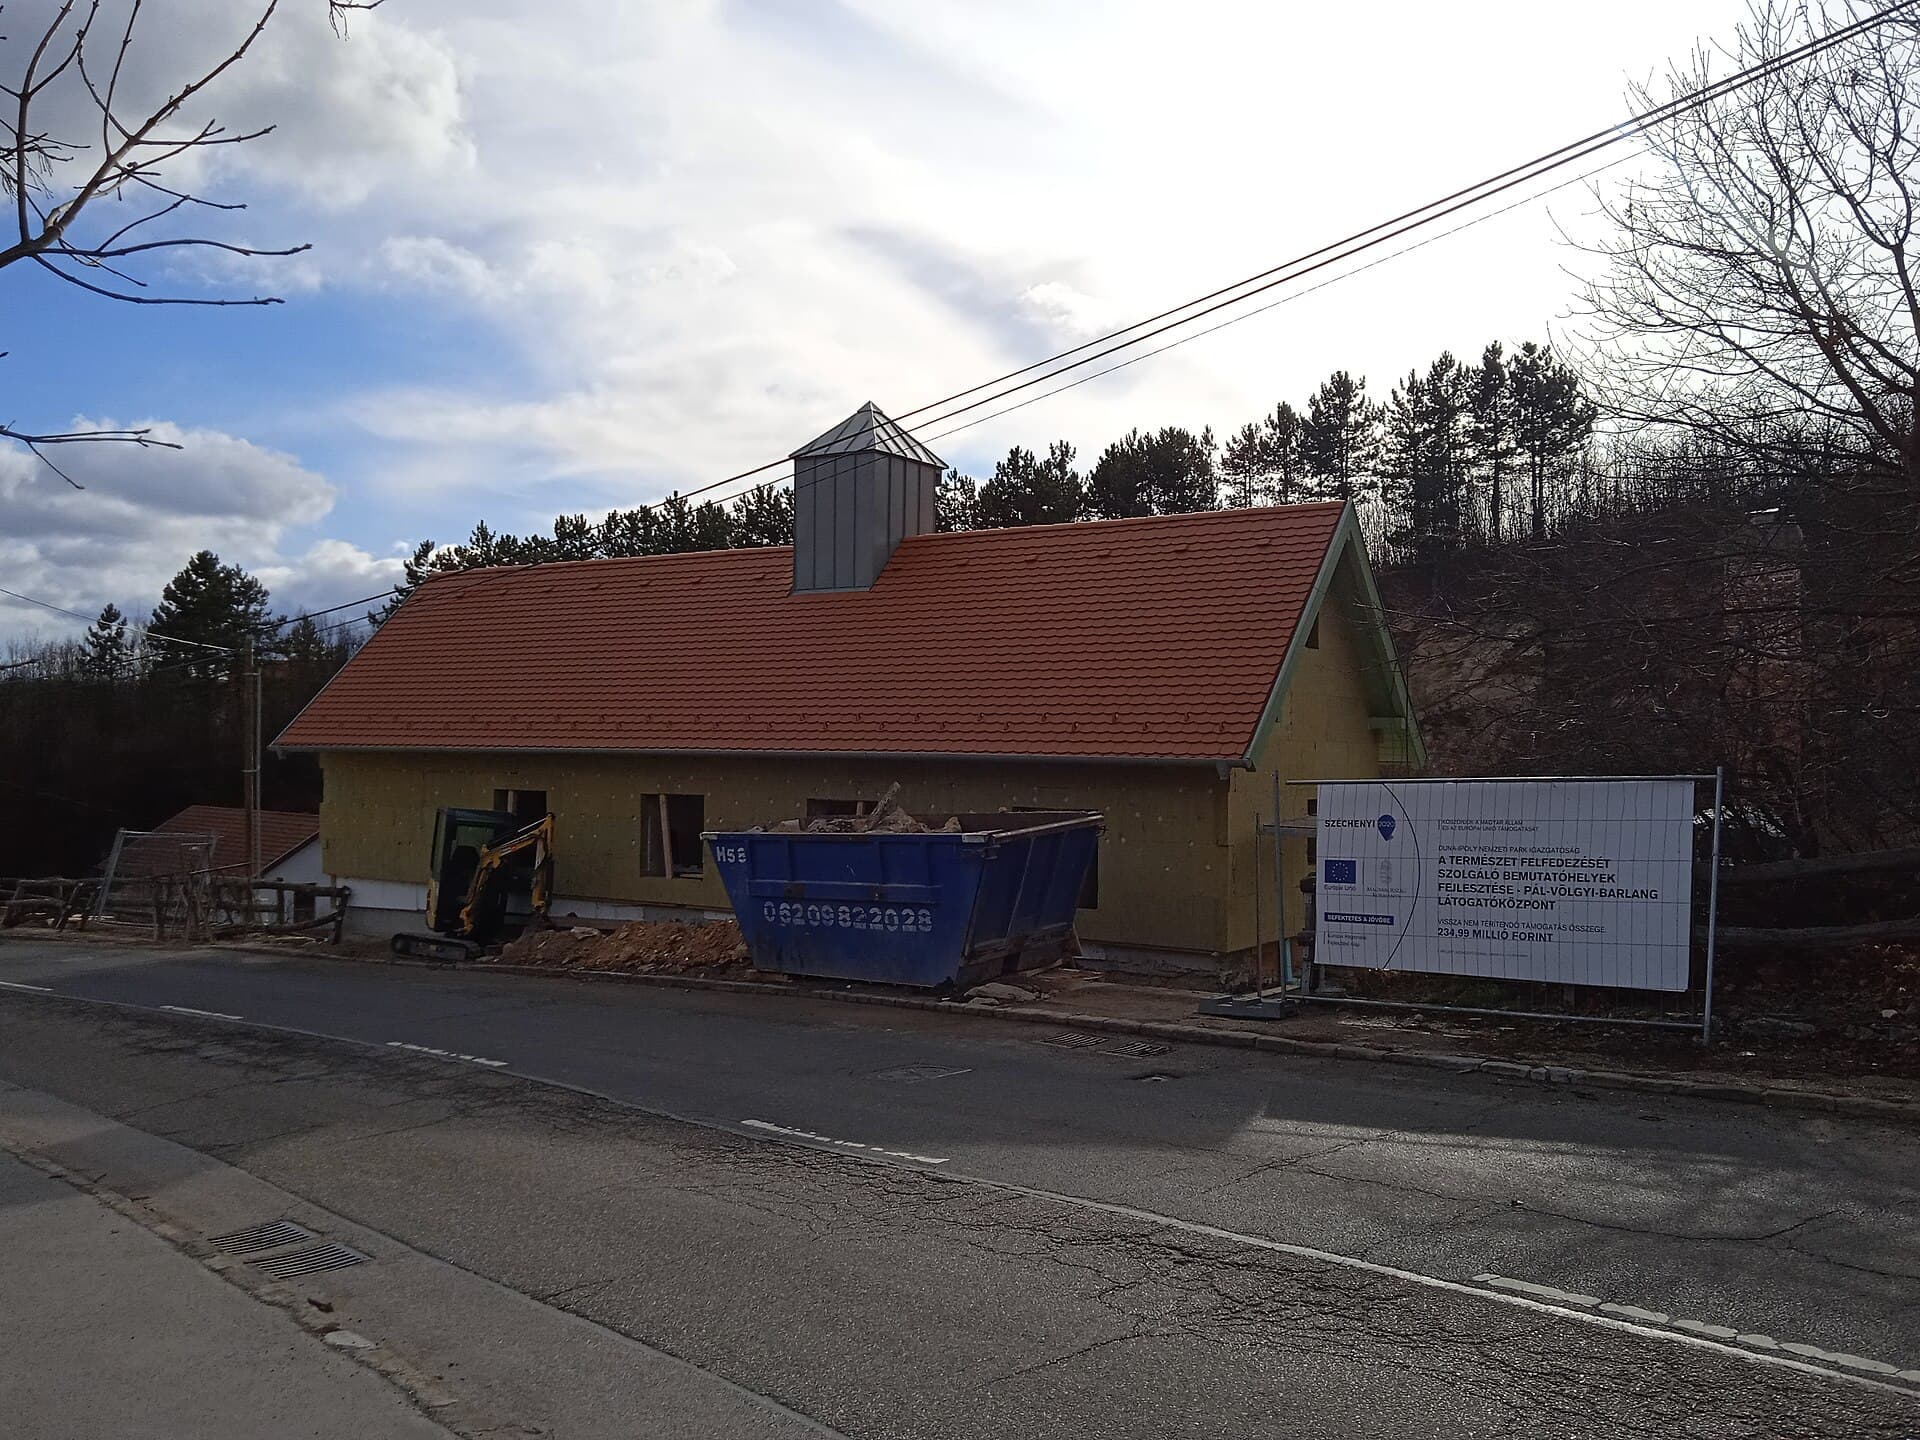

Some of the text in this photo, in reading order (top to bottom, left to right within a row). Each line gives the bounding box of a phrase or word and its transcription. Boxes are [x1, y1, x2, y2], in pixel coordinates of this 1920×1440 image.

[1324, 817, 1376, 828] SZÉCHENYI
[1438, 854, 1610, 869] A TERMÉSZET FELFEDEZÉSÉT
[1438, 868, 1616, 883] SZOLGÁLÓ BEMUTATÓHELYEK
[1438, 882, 1514, 895] FEJLESZTÉSE
[1438, 896, 1555, 910] LÁTOGATÓKÖZPONT
[763, 900, 933, 932] 06209822028
[1464, 919, 1479, 927] NEM
[1521, 921, 1567, 931] TÁMOGATÁS
[1437, 928, 1554, 942] 234,99 MILLIÓ FORINT
